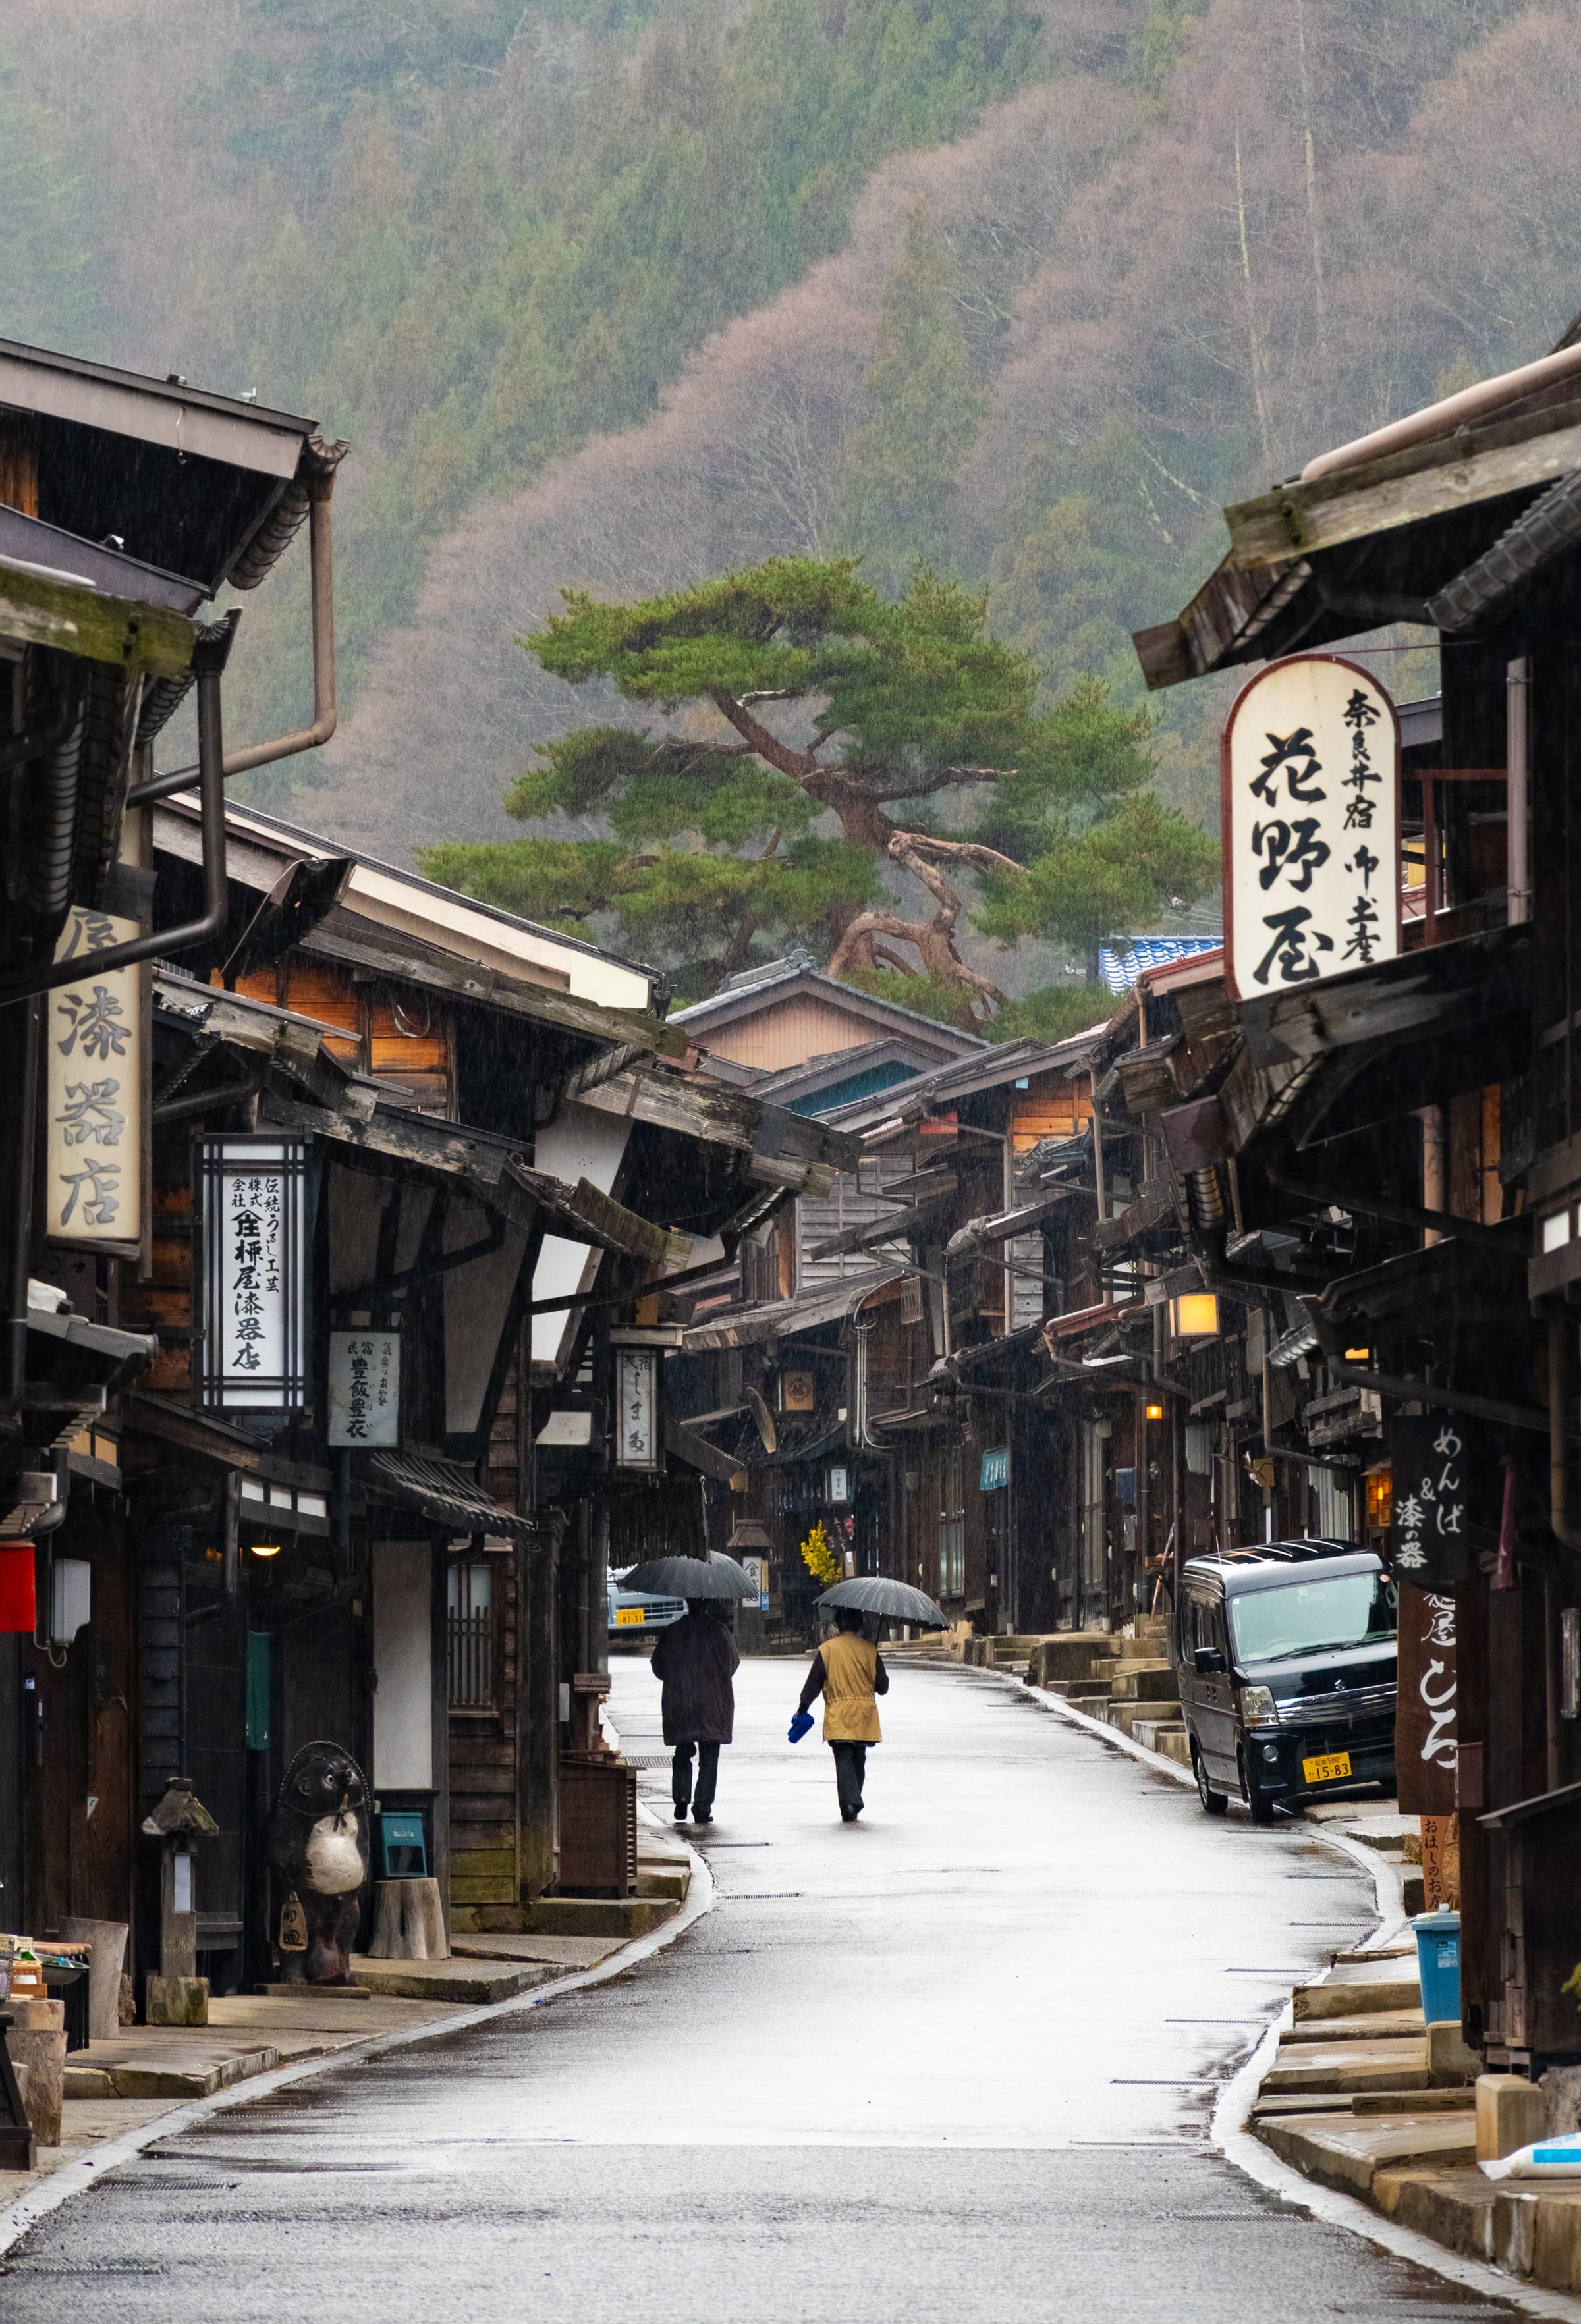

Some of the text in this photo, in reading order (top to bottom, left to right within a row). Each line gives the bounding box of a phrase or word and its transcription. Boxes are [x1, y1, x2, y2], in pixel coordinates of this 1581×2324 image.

[1341, 689, 1382, 830] 奈良井宿
[1249, 728, 1334, 985] 花野屋
[264, 1177, 281, 1292] 伝統うるし工芸
[1433, 1425, 1464, 1535] めんぱ
[1395, 1493, 1428, 1568] 漆の器
[623, 1615, 642, 1624] 87-31
[1317, 1763, 1349, 1779] 15-83
[1424, 1819, 1441, 1909] おはしのお店
